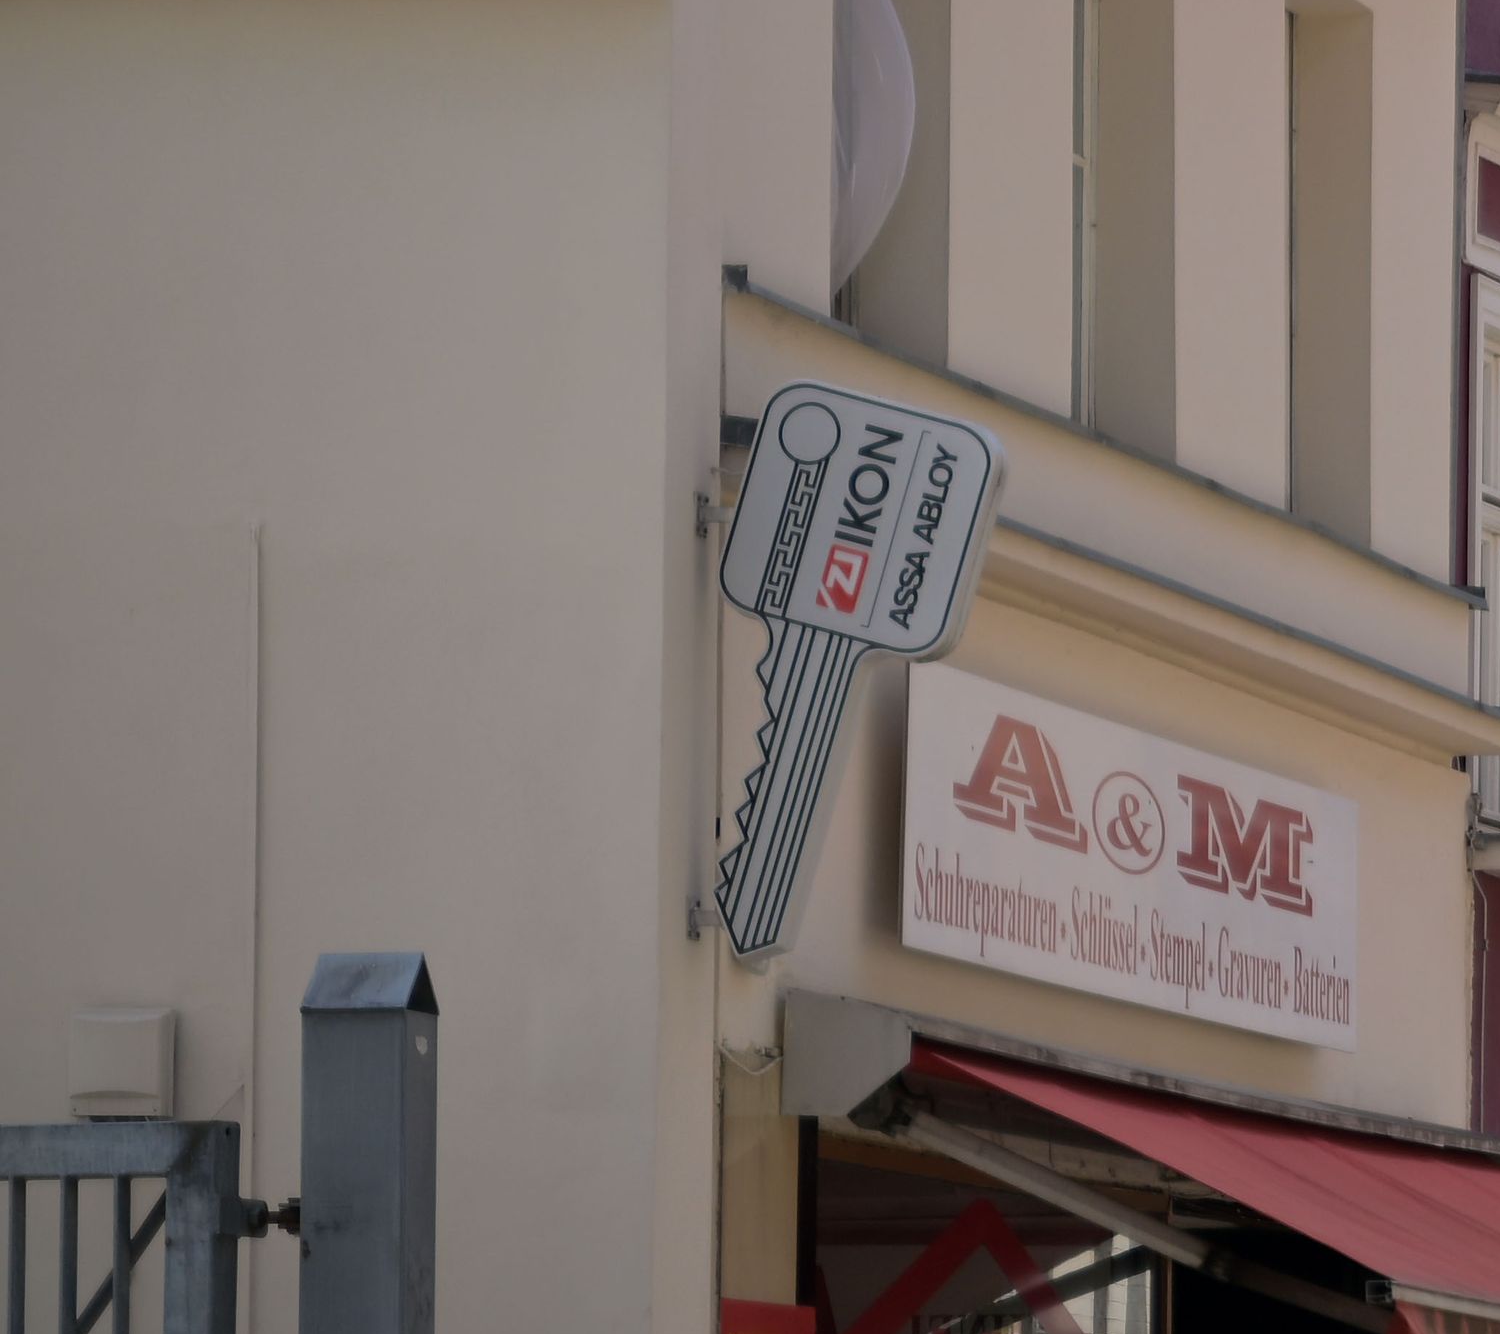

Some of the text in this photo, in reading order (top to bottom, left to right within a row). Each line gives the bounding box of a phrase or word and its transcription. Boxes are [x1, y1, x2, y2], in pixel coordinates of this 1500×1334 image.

[833, 423, 905, 548] IKON
[888, 443, 958, 631] ASSA ABLOY
[953, 713, 1088, 854] A
[1176, 774, 1313, 917] M
[913, 841, 1350, 1026] Schuhreparaturen Schlüssel Stempel Gravuren Batterien
